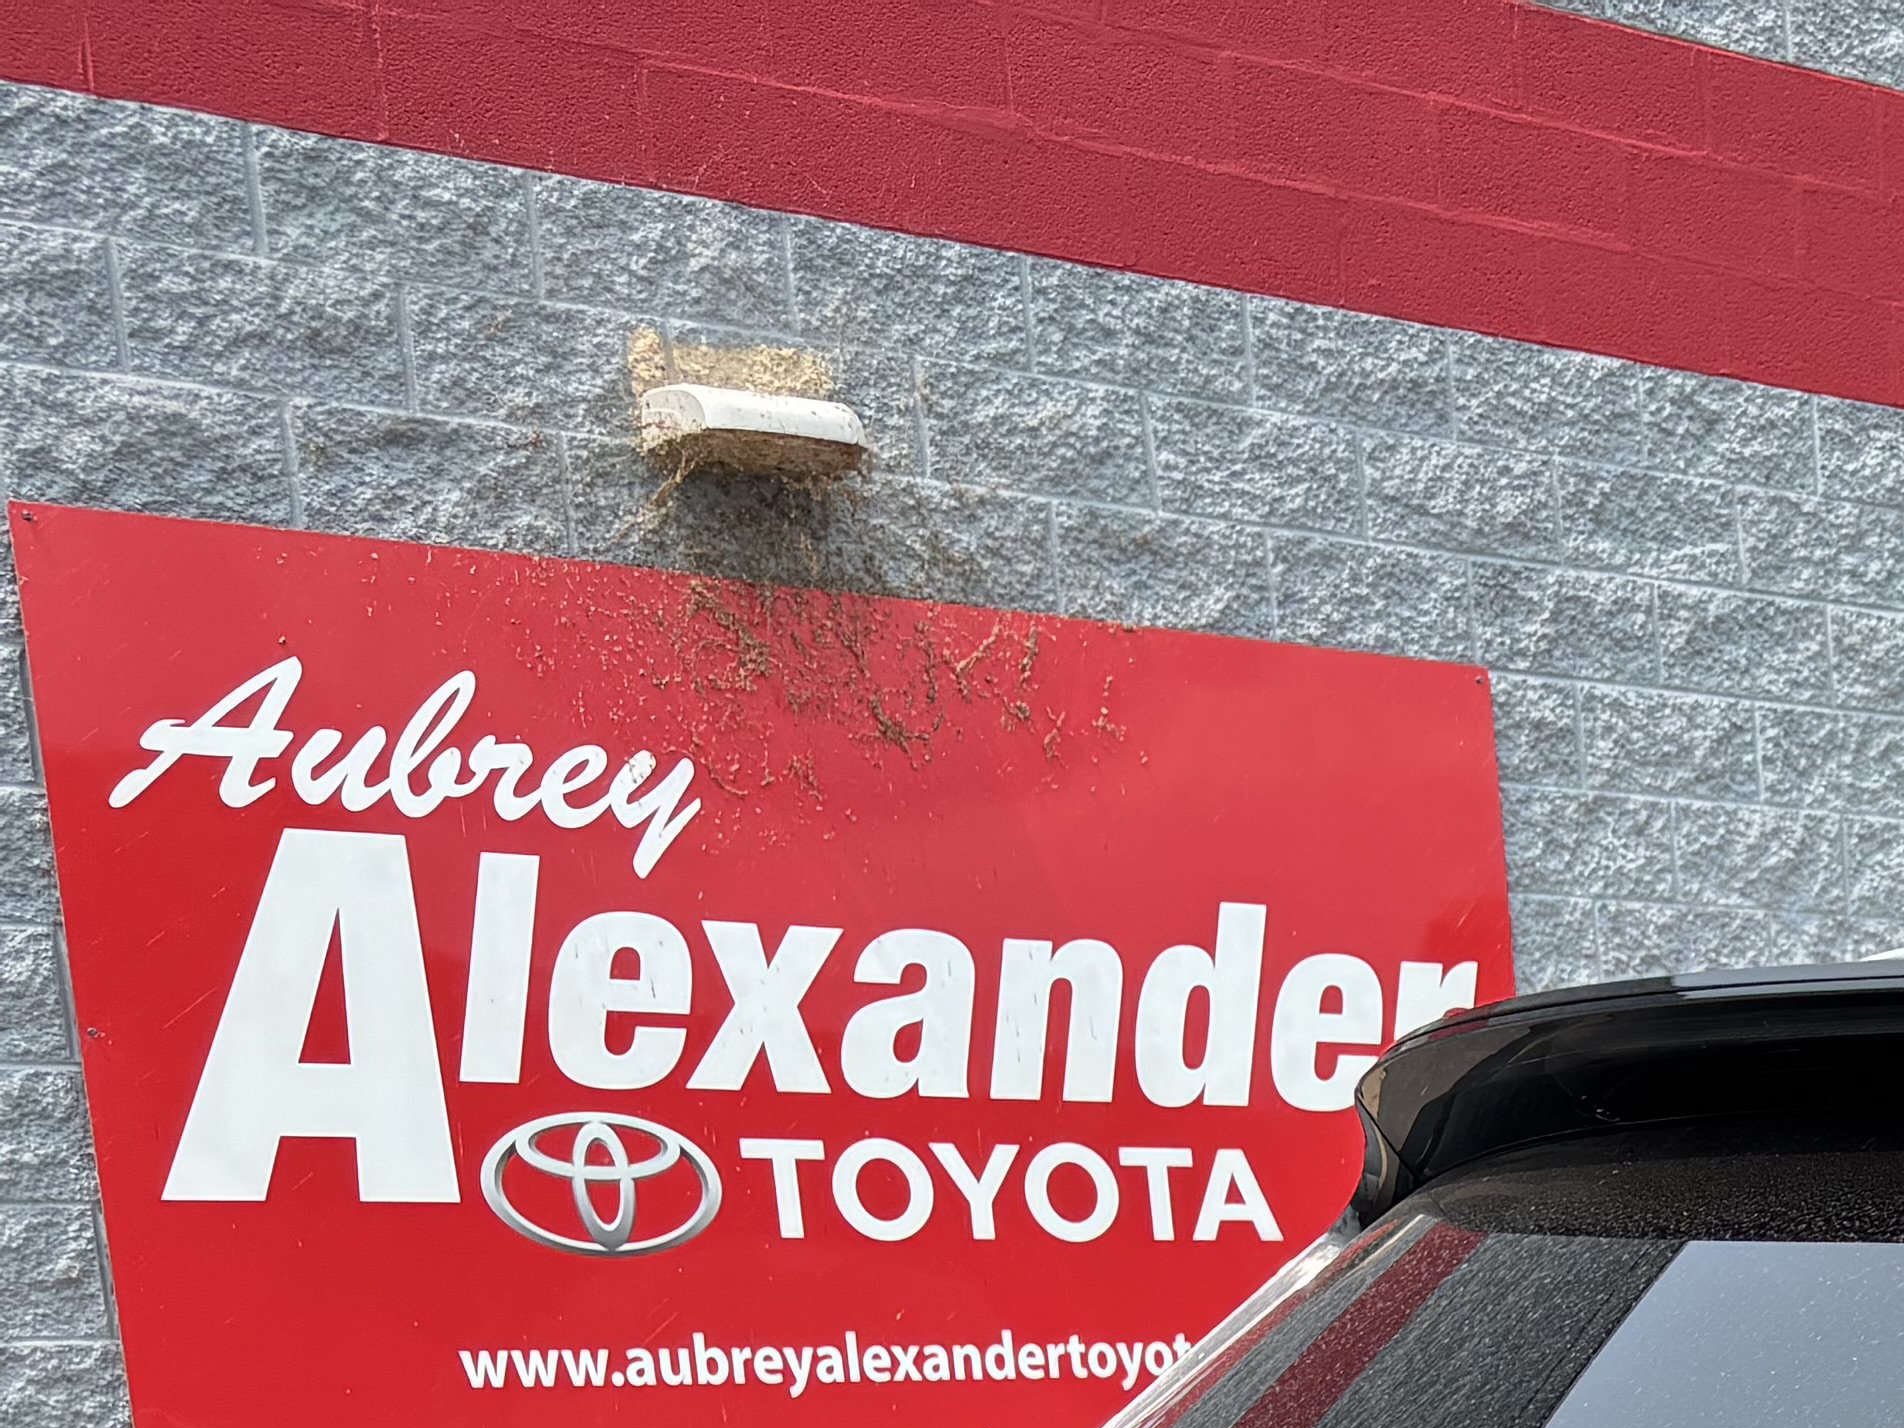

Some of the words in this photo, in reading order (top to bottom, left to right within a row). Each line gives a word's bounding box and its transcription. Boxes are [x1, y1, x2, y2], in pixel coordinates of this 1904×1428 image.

[109, 655, 702, 879] Aubrey
[161, 827, 1479, 1203] Alexander
[739, 1137, 1284, 1244] TOYOTA
